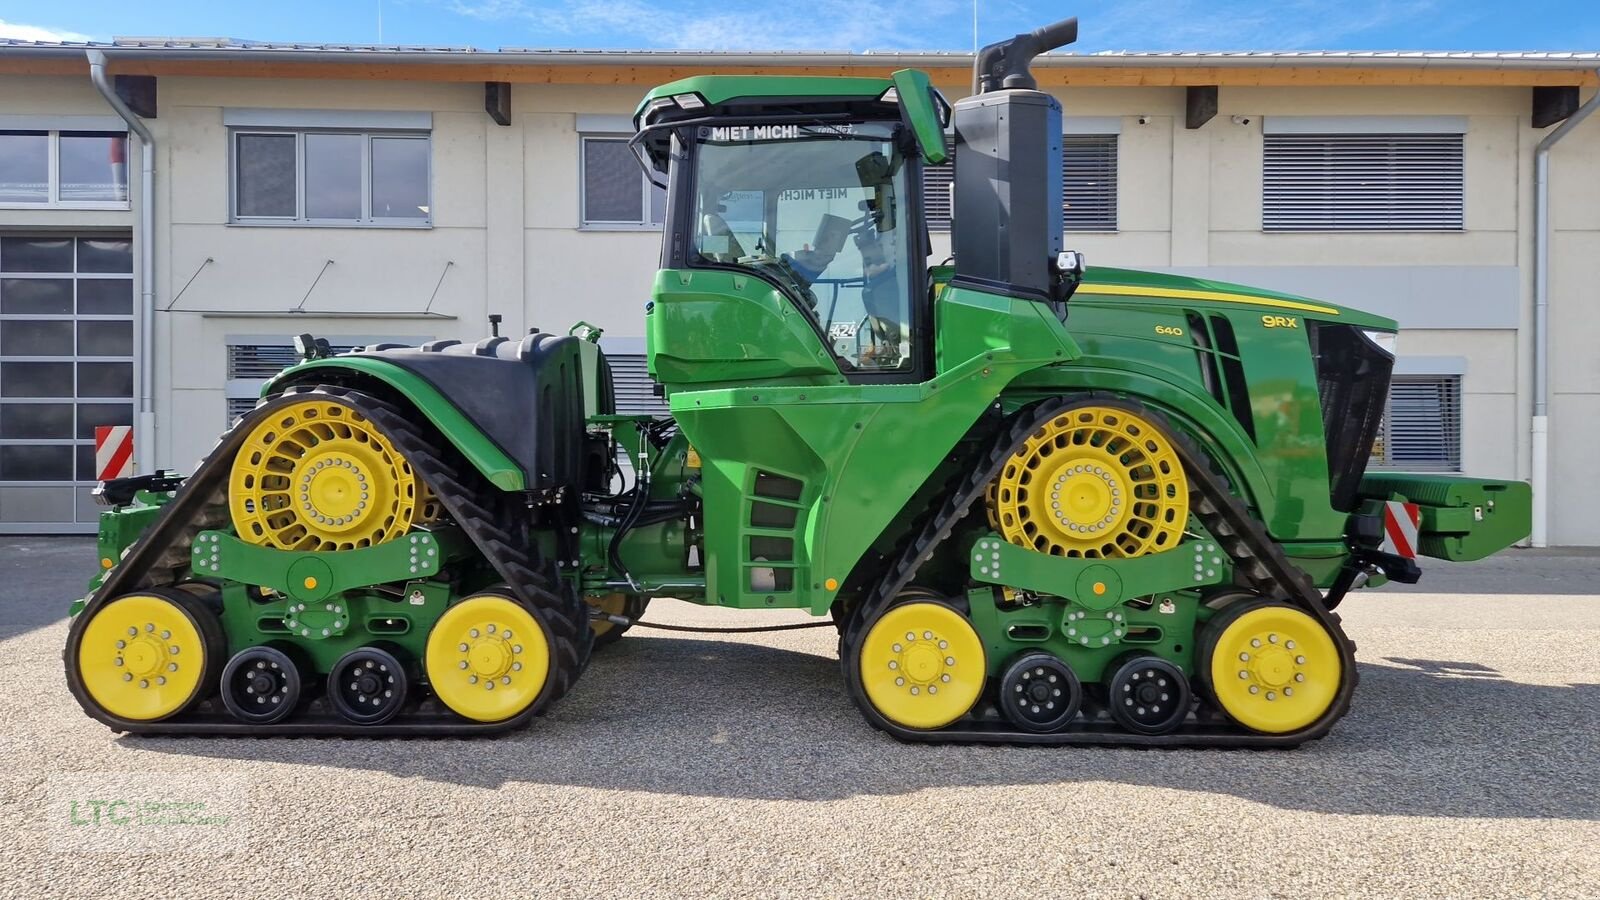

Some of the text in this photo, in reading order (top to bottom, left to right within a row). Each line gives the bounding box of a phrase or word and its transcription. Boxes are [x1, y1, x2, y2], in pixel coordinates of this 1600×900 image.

[712, 125, 798, 140] MIET MICH!
[1262, 315, 1298, 329] 9RX
[1155, 325, 1183, 336] 640
